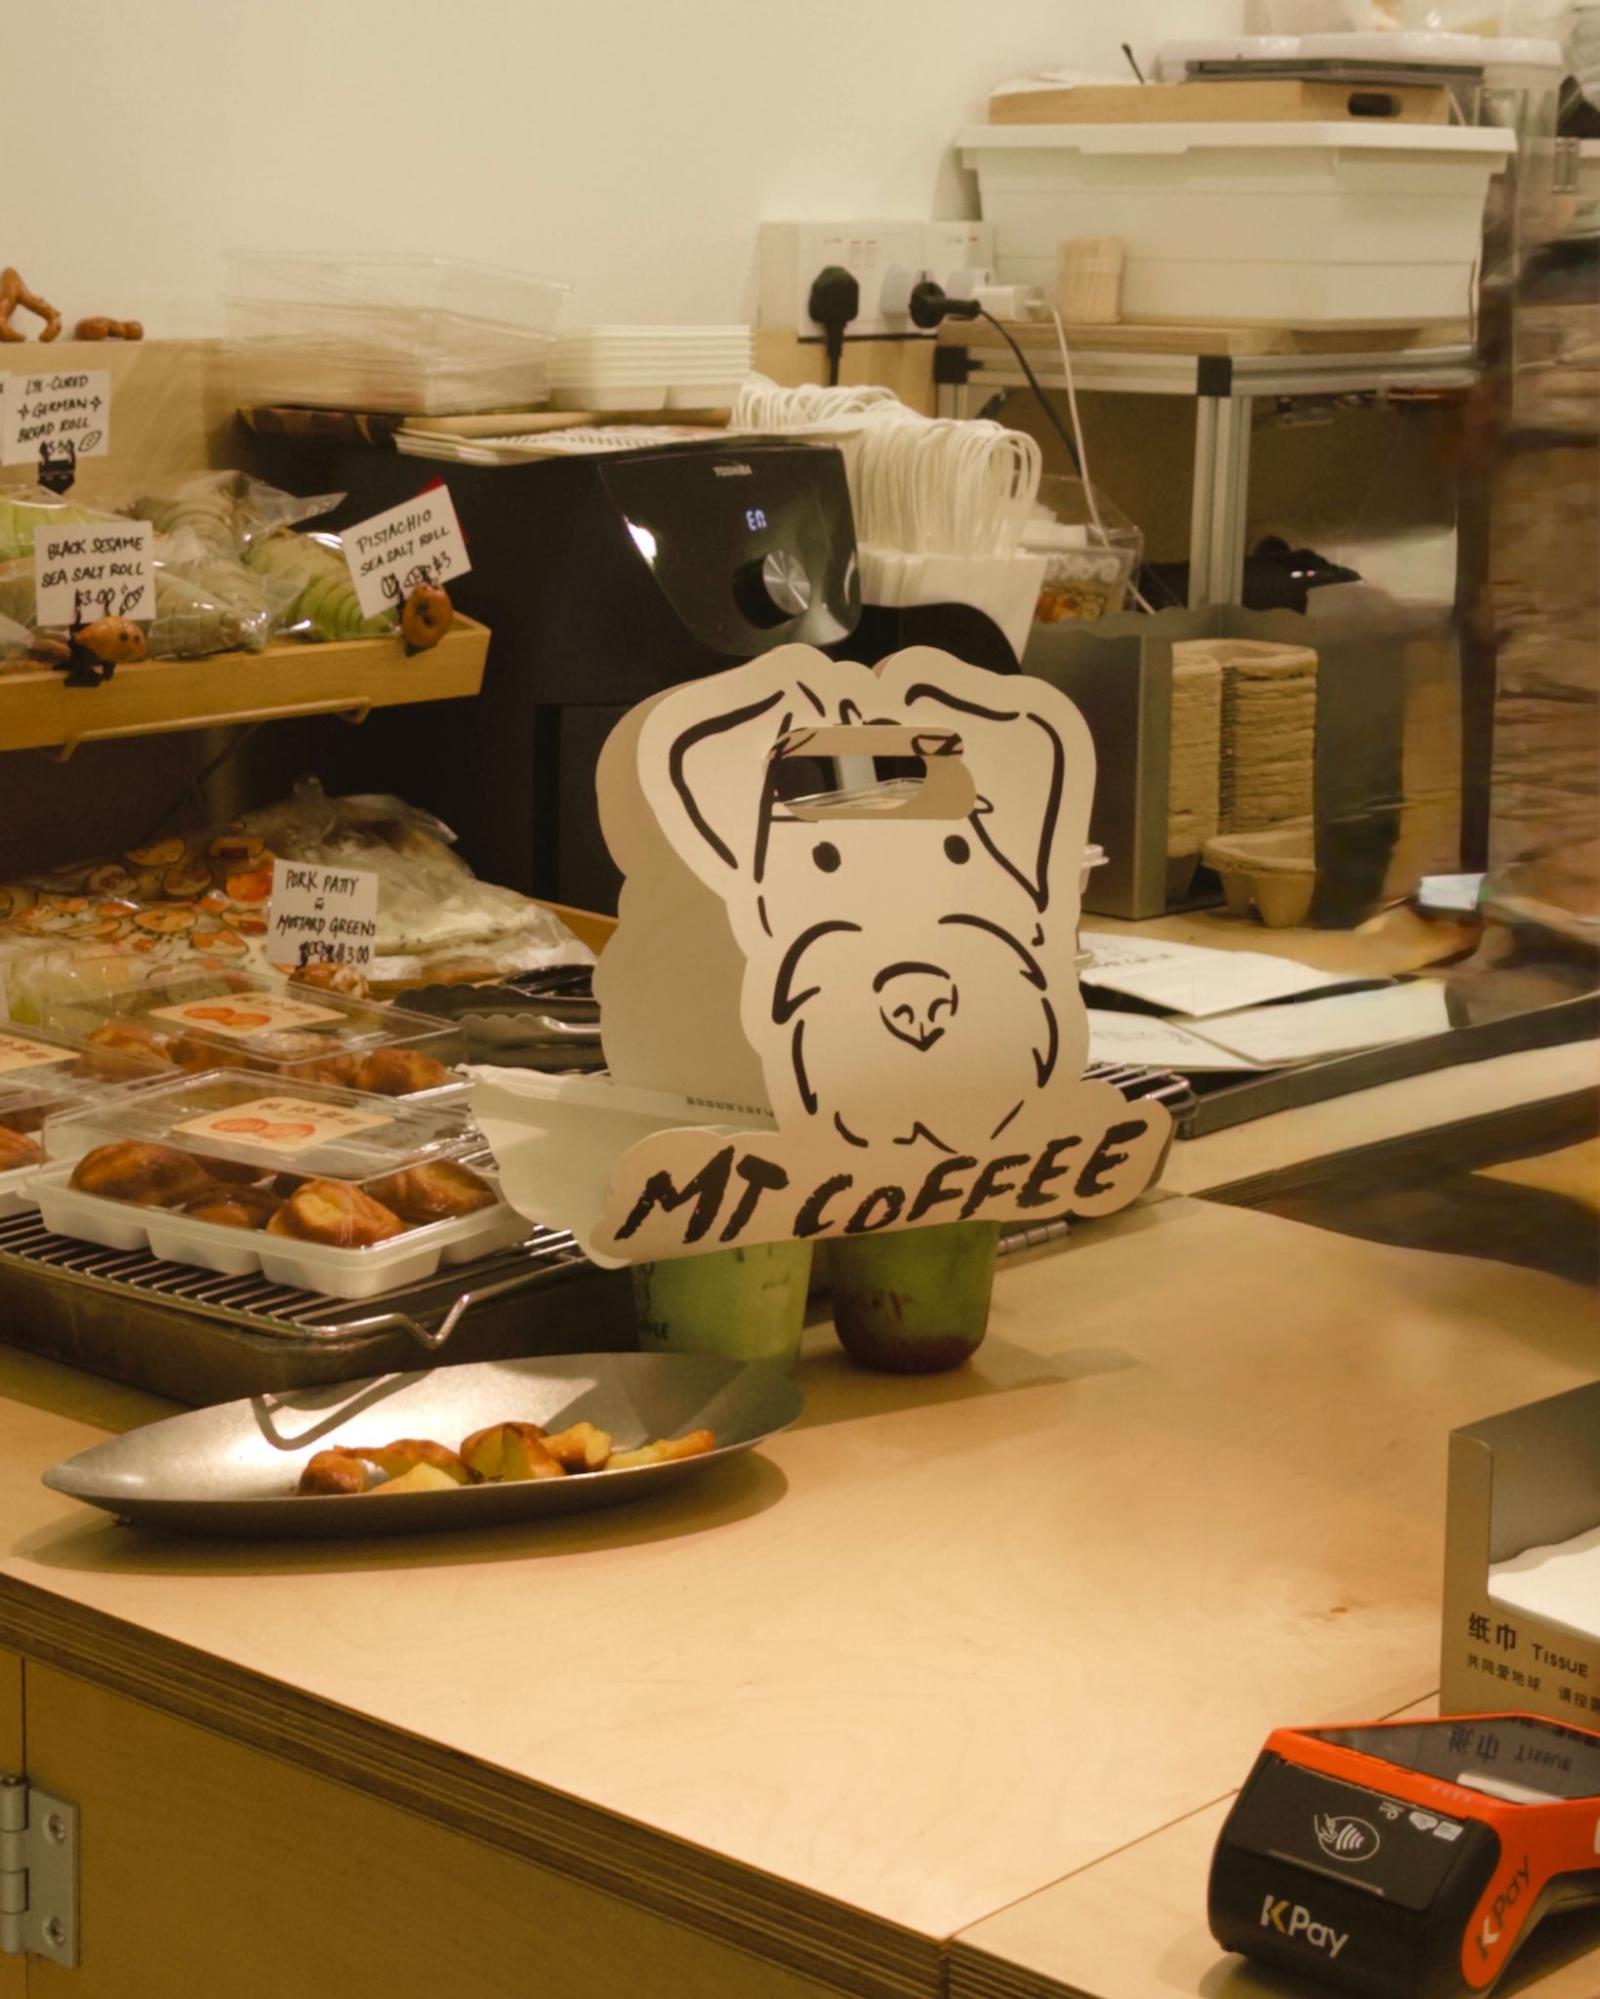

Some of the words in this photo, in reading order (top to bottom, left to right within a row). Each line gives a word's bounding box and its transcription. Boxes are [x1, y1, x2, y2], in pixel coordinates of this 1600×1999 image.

[32, 398, 87, 418] GERMAN
[59, 417, 91, 432] ROLL
[47, 539, 87, 561] BLACK
[91, 536, 145, 555] SESAME
[356, 509, 432, 555] PISTACHIO
[360, 555, 385, 577] SEA
[387, 541, 414, 563] SALT
[420, 526, 450, 548] ROLL
[41, 568, 68, 589] SEA
[71, 565, 105, 582] SALT
[110, 562, 144, 577] ROLL
[286, 868, 318, 894] PORK
[322, 875, 360, 897] PATTY
[614, 1144, 790, 1244] MT
[793, 1119, 1149, 1238] COFFEE
[1468, 1612, 1517, 1652] 纸巾
[1259, 1893, 1350, 1959] KPay
